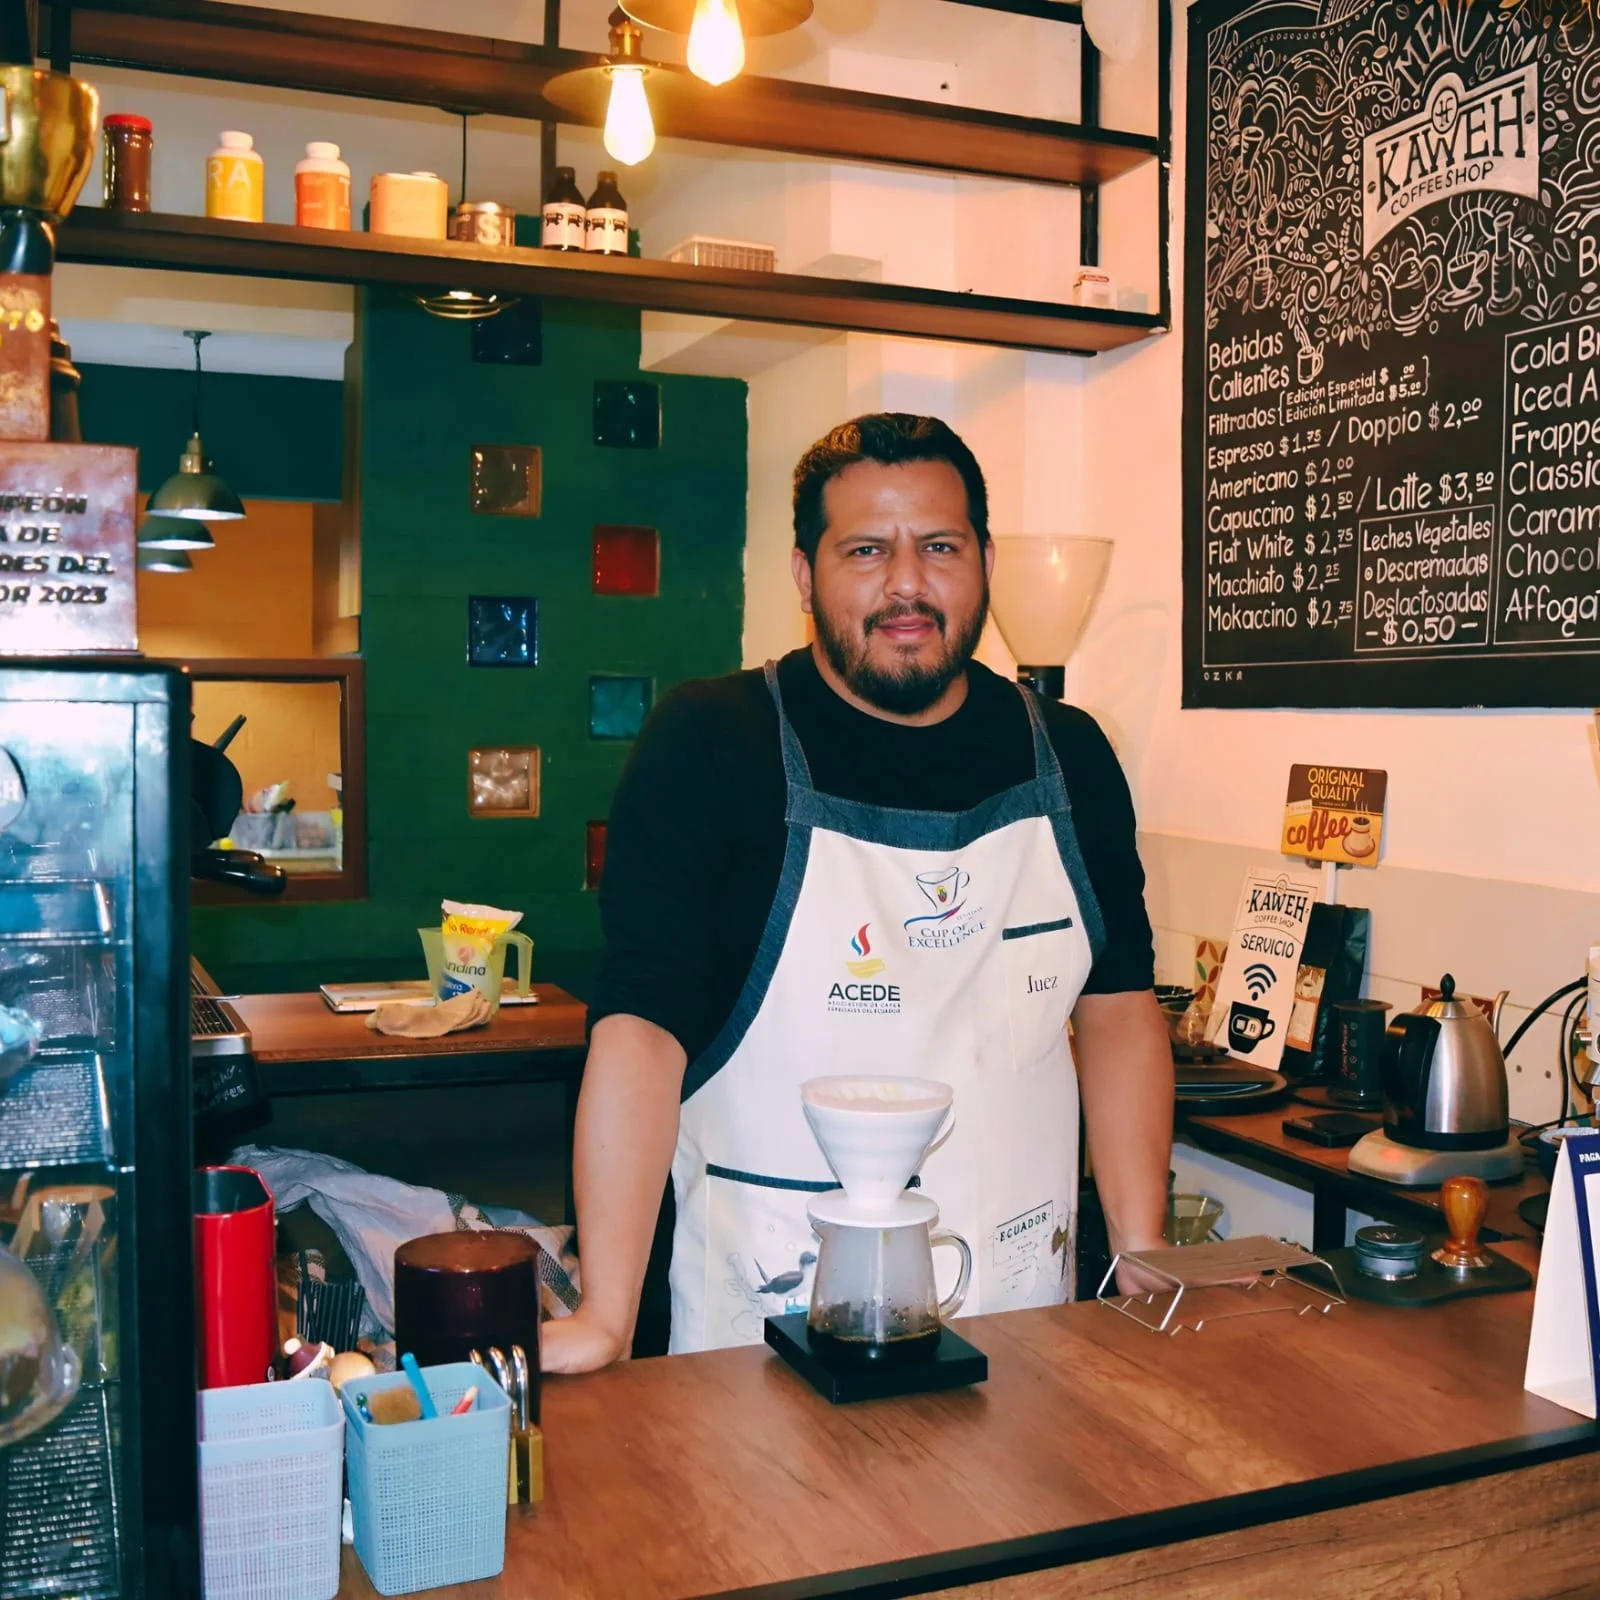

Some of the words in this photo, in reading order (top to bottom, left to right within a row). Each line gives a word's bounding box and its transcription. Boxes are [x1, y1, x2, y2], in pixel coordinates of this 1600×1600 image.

[1376, 85, 1526, 213] KAWEH
[1390, 174, 1443, 216] COFFEE
[1446, 160, 1495, 188] SHOP
[1209, 329, 1284, 371] Bebidas
[1510, 332, 1570, 374] Cold
[1209, 363, 1290, 402] Calientes
[1286, 382, 1325, 405] Edición
[1328, 369, 1377, 397] Especial
[1514, 372, 1573, 416] Iced
[1209, 405, 1276, 436] Filtrados
[1286, 399, 1326, 423] Edición
[1328, 387, 1385, 413] Limitada
[1208, 441, 1274, 473] Espresso
[1348, 406, 1421, 447] Doppio
[1208, 471, 1299, 501] Americano
[1208, 500, 1294, 538] Capuccino
[1376, 472, 1433, 513] Latte
[17, 527, 60, 544] DE
[1209, 537, 1241, 565] Flat
[1247, 528, 1294, 561] White
[1363, 523, 1413, 551] Leches
[1415, 511, 1492, 554] Vegetales
[57, 555, 114, 575] DEL
[1208, 565, 1285, 598] Macchiato
[1376, 546, 1488, 584] Descremadas
[38, 585, 107, 604] 2023
[1363, 581, 1488, 620] Deslactosadas
[1504, 585, 1600, 638] Affoga
[1208, 602, 1297, 632] Mokaccino
[1308, 767, 1364, 788] ORIGINAL
[1310, 783, 1359, 802] QUALITY
[1286, 809, 1353, 852] coffee
[1247, 889, 1308, 923] KAWEH
[1254, 914, 1278, 924] COFFEE
[1279, 919, 1295, 928] SHOP
[1240, 933, 1295, 959] SERVICIO
[828, 983, 901, 1001] ACEDE
[1027, 974, 1058, 994] Juez
[1000, 1211, 1048, 1242] ECUADOR
